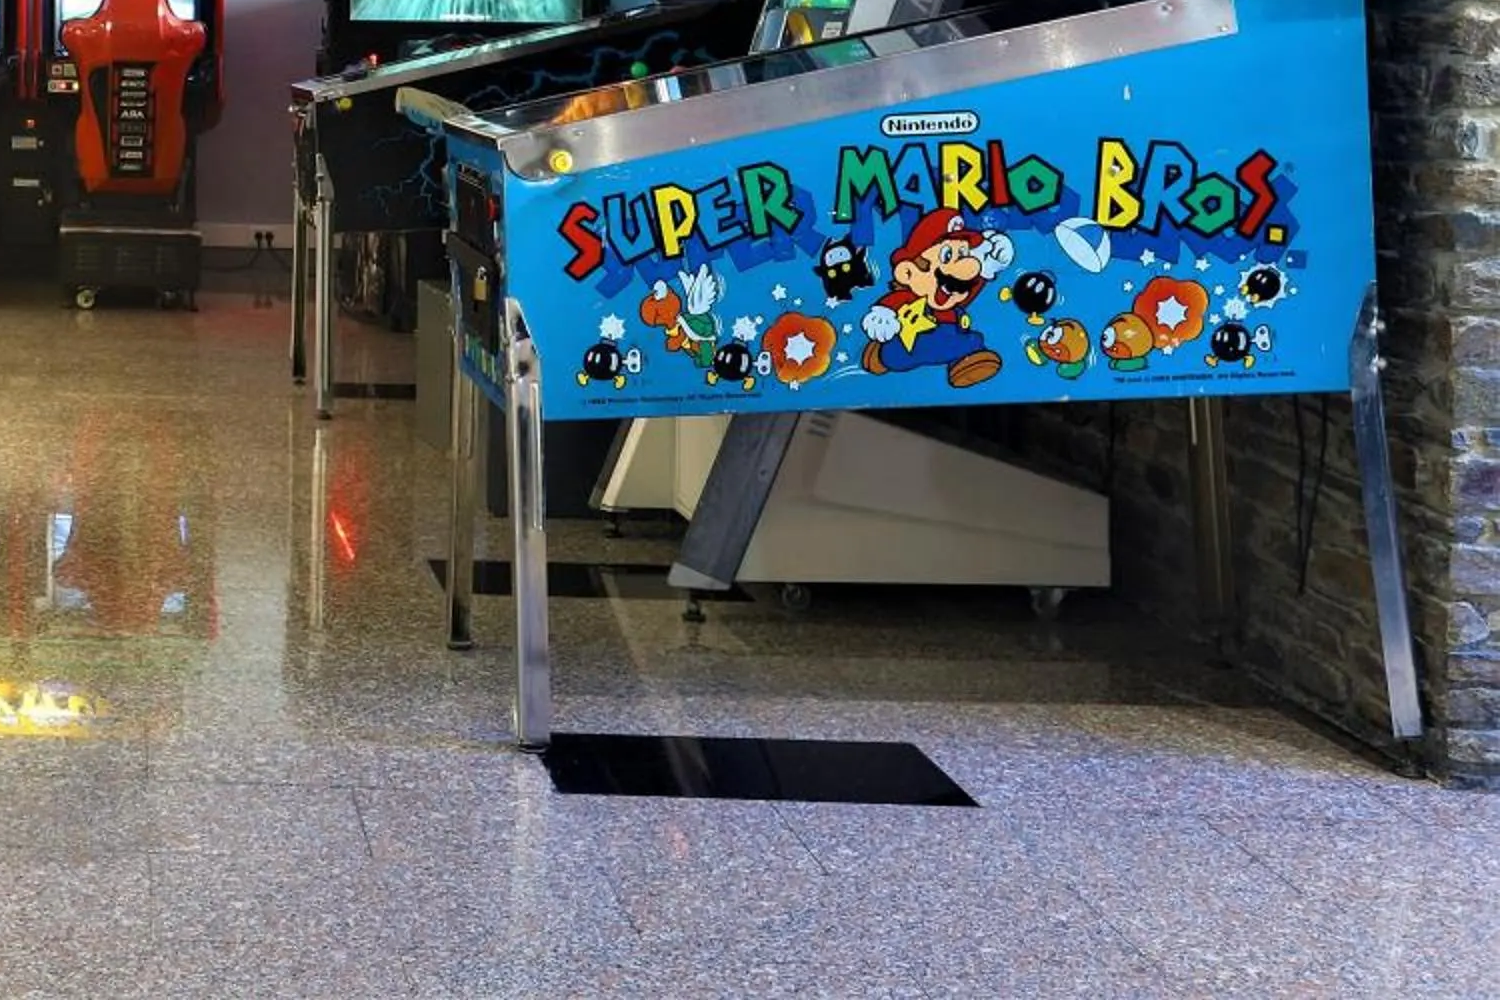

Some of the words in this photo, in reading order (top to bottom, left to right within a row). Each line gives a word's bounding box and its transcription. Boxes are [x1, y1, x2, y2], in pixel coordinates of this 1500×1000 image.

[889, 116, 974, 132] Nintendo
[557, 160, 806, 282] SUPER
[833, 139, 1064, 223] MARIO
[1095, 137, 1288, 245] BROS.
